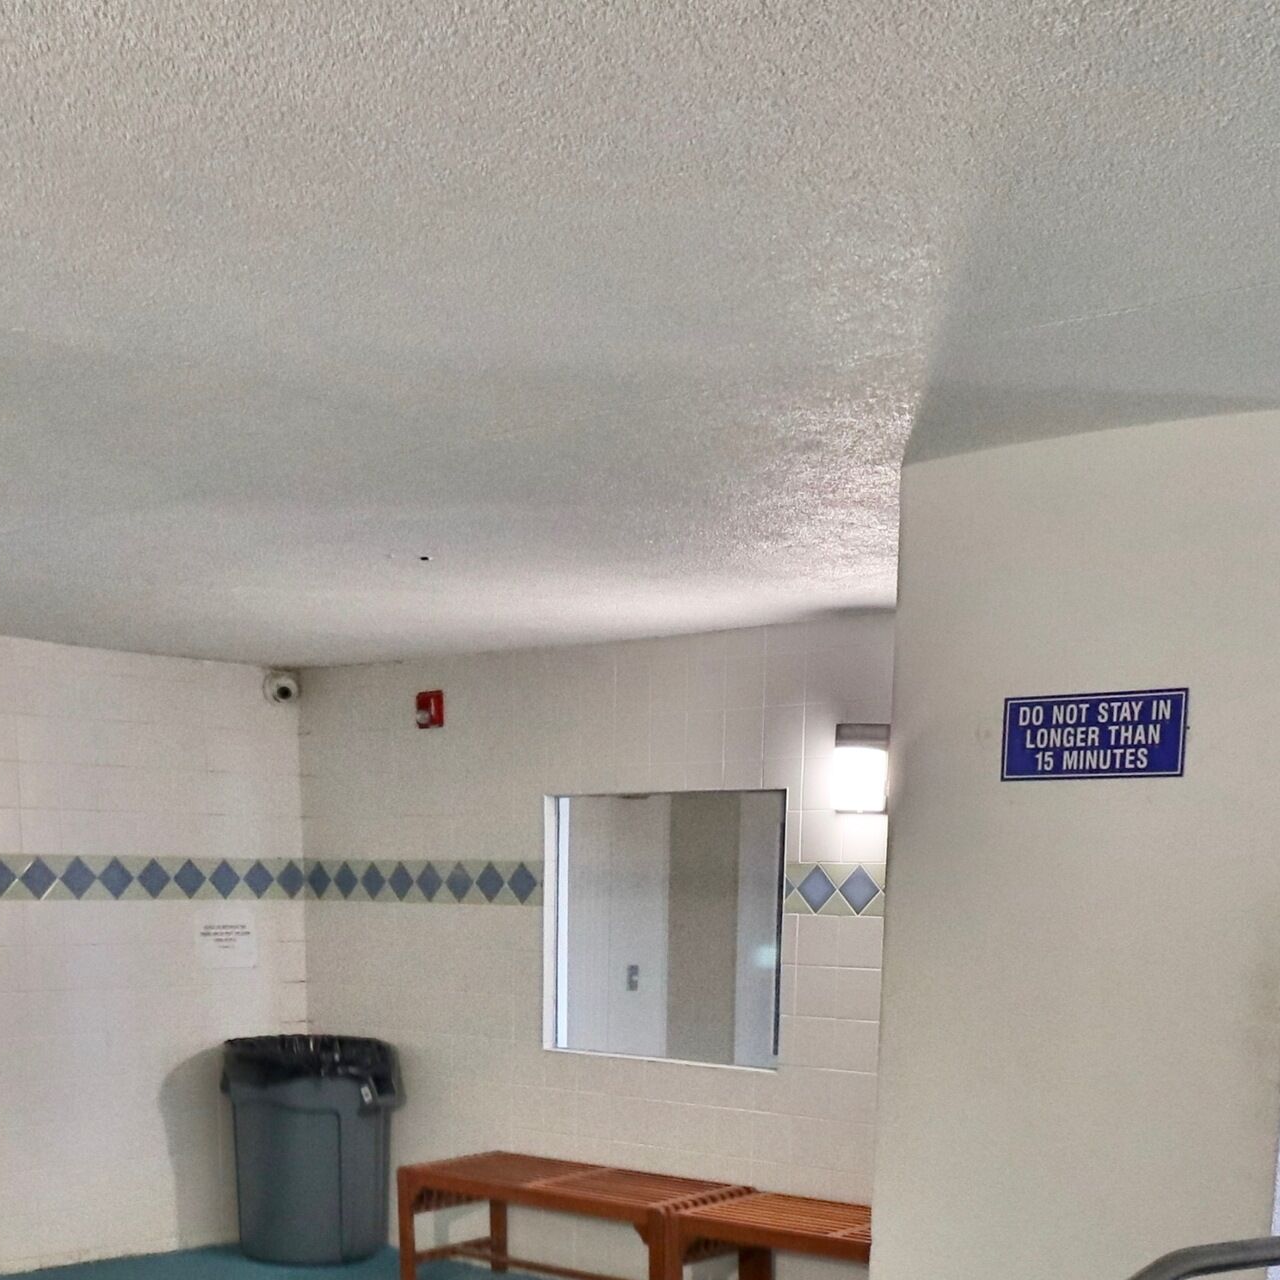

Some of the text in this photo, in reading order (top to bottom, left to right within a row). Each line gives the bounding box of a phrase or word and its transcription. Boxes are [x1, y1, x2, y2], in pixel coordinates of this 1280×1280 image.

[1019, 700, 1171, 726] DO NOT STAY IN
[1025, 724, 1161, 748] LONGER THAN
[1035, 748, 1148, 771] 15 MINUTES
